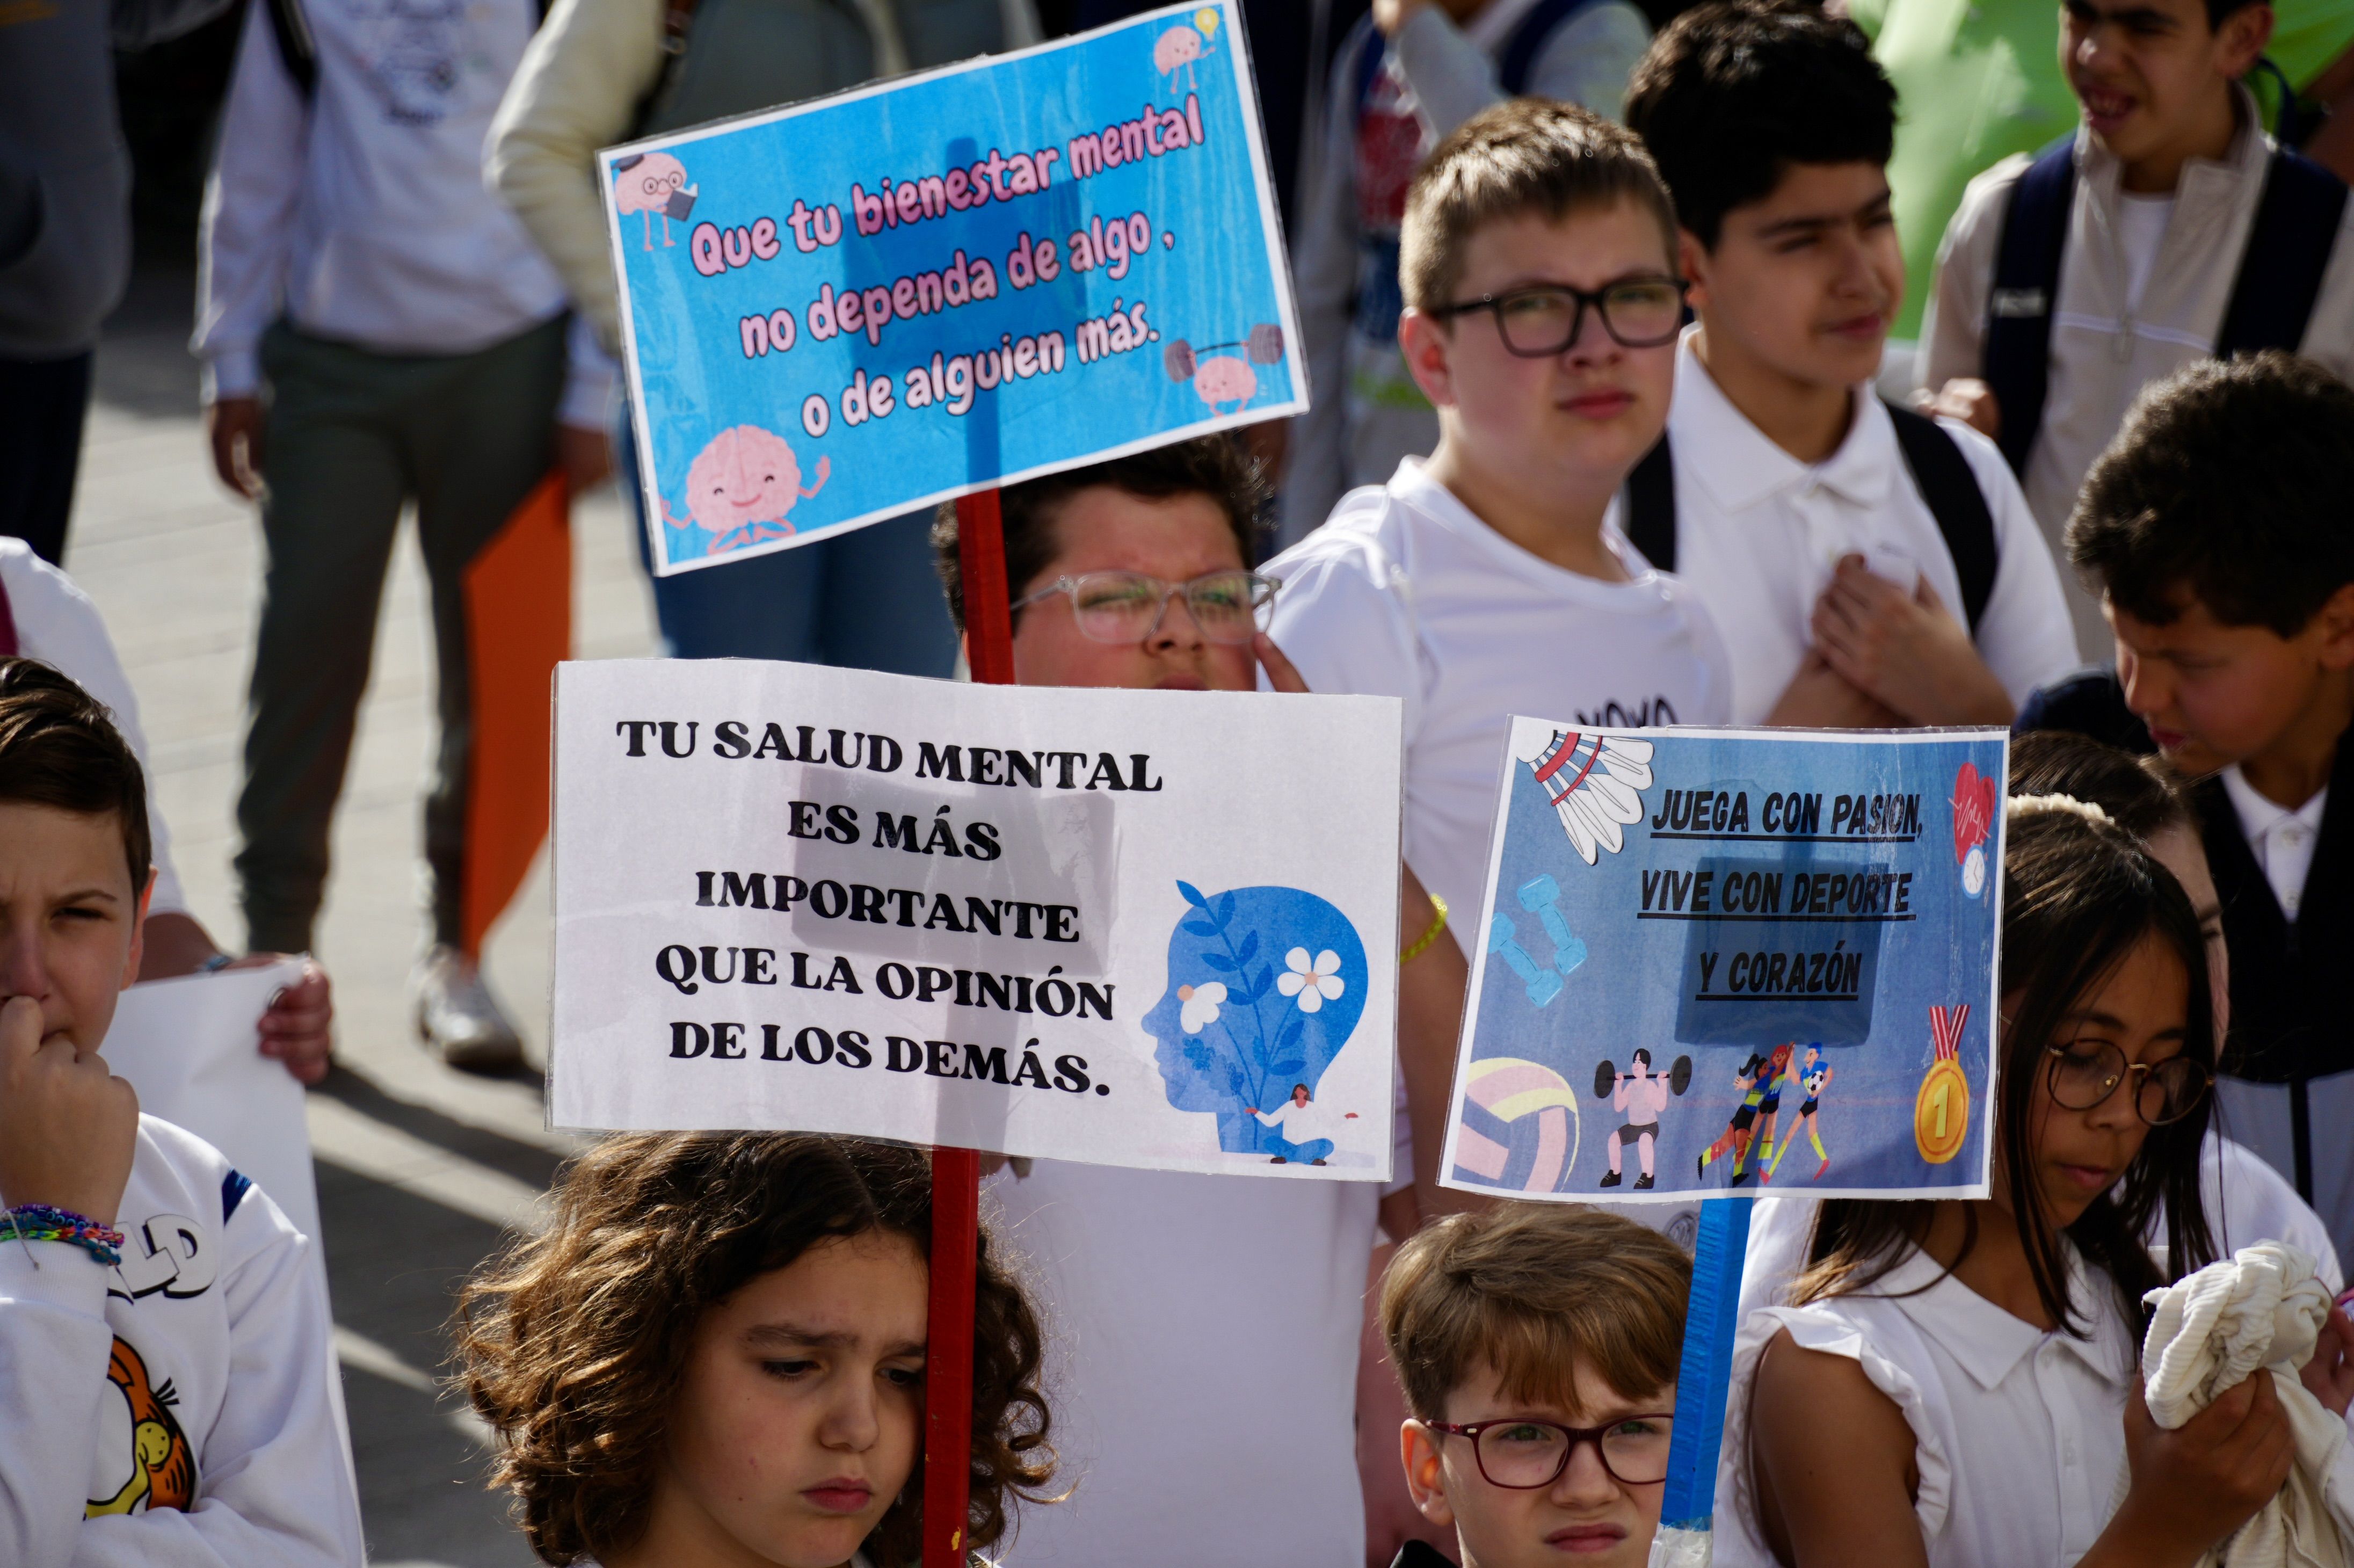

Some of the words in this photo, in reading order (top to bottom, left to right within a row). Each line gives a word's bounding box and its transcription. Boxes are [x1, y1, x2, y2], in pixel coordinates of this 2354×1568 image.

[690, 217, 781, 277] Que
[787, 199, 843, 252] tu
[851, 148, 1059, 238] bienestar
[1067, 92, 1205, 180] mental
[739, 308, 797, 359] no
[807, 249, 998, 346] dependa
[1007, 231, 1060, 291] de
[801, 394, 830, 439] o
[841, 369, 895, 427] de
[904, 330, 1065, 415] alguien
[1077, 297, 1160, 364] más.
[617, 722, 699, 758] TU
[714, 722, 902, 772] SALUD
[916, 742, 1162, 791] MENTAL
[788, 802, 860, 844] ES
[872, 805, 1001, 861] MÁS
[1653, 790, 1748, 832] JUEGA
[1763, 793, 1822, 833] CON
[696, 872, 1079, 942] IMPORTANTE
[1643, 870, 1714, 911] VIVE
[1721, 872, 1783, 914] CON
[1790, 870, 1912, 914] DEPORTE
[656, 945, 776, 994] QUE
[790, 953, 863, 993] LA
[876, 963, 1114, 1020] OPINIÓN
[1701, 952, 1719, 993] Y
[1728, 940, 1863, 993] CORAZÓN
[670, 1022, 746, 1058] DE
[761, 1025, 871, 1068] LOS
[885, 1037, 1109, 1095] DEMÁS.
[1934, 1083, 1950, 1139] 1
